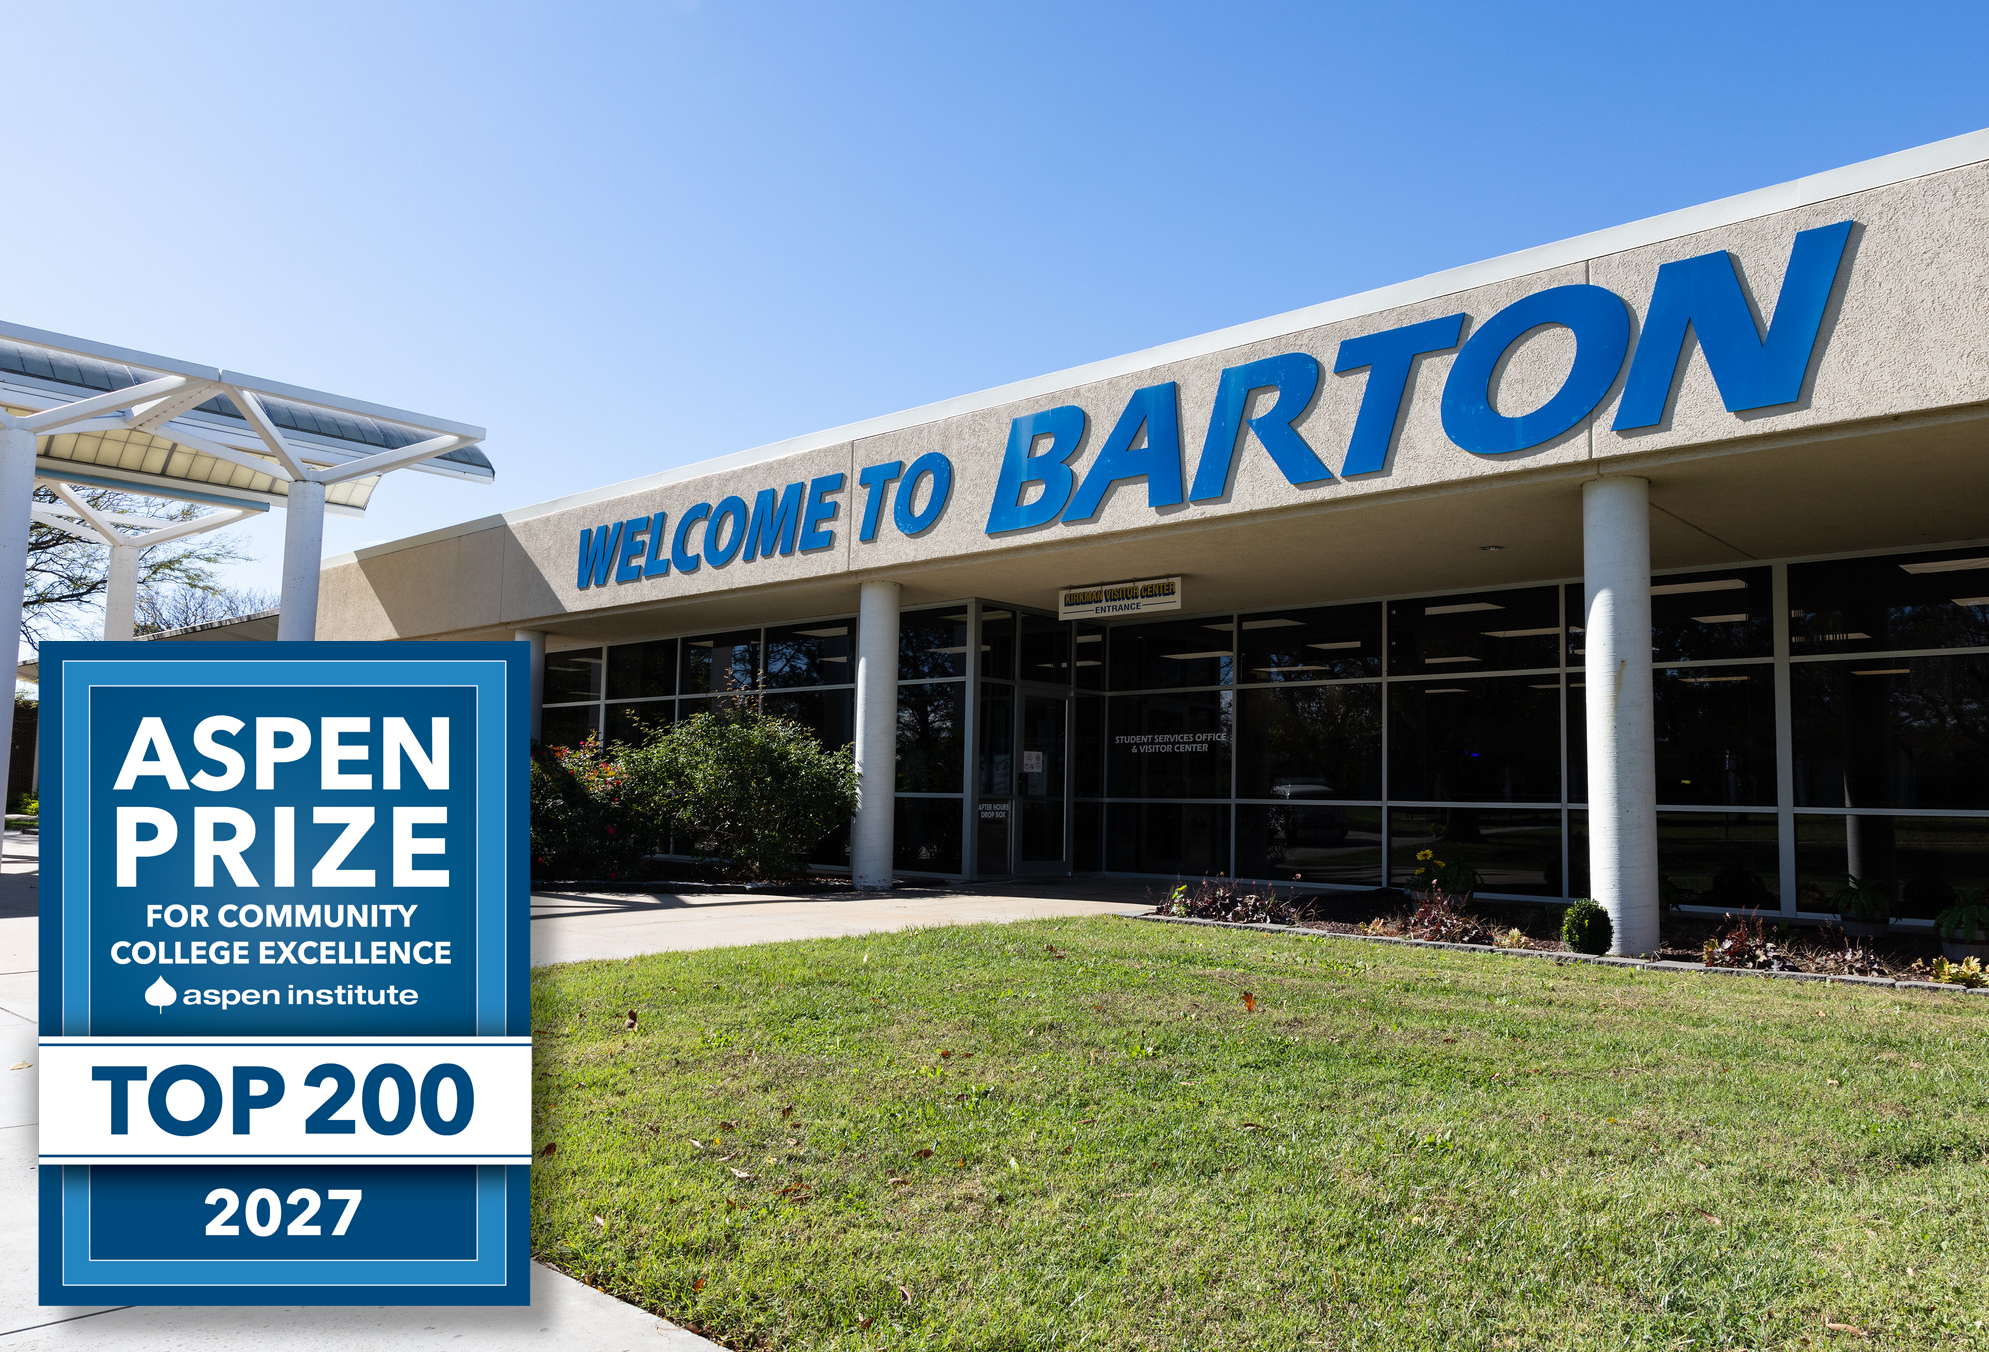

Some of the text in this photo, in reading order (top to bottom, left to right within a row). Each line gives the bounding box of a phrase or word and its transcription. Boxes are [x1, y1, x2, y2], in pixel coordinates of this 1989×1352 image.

[577, 220, 1854, 589] WELCOME TO BARTON
[1064, 581, 1176, 607] KIRKMAN VISITOR CENTER
[1095, 602, 1142, 614] ENTRANCE
[1115, 732, 1227, 744] STUDENT SERVICES OFFICE
[1131, 743, 1208, 753] & VISITOR CENTER
[978, 803, 1009, 811] AFTER HOURS
